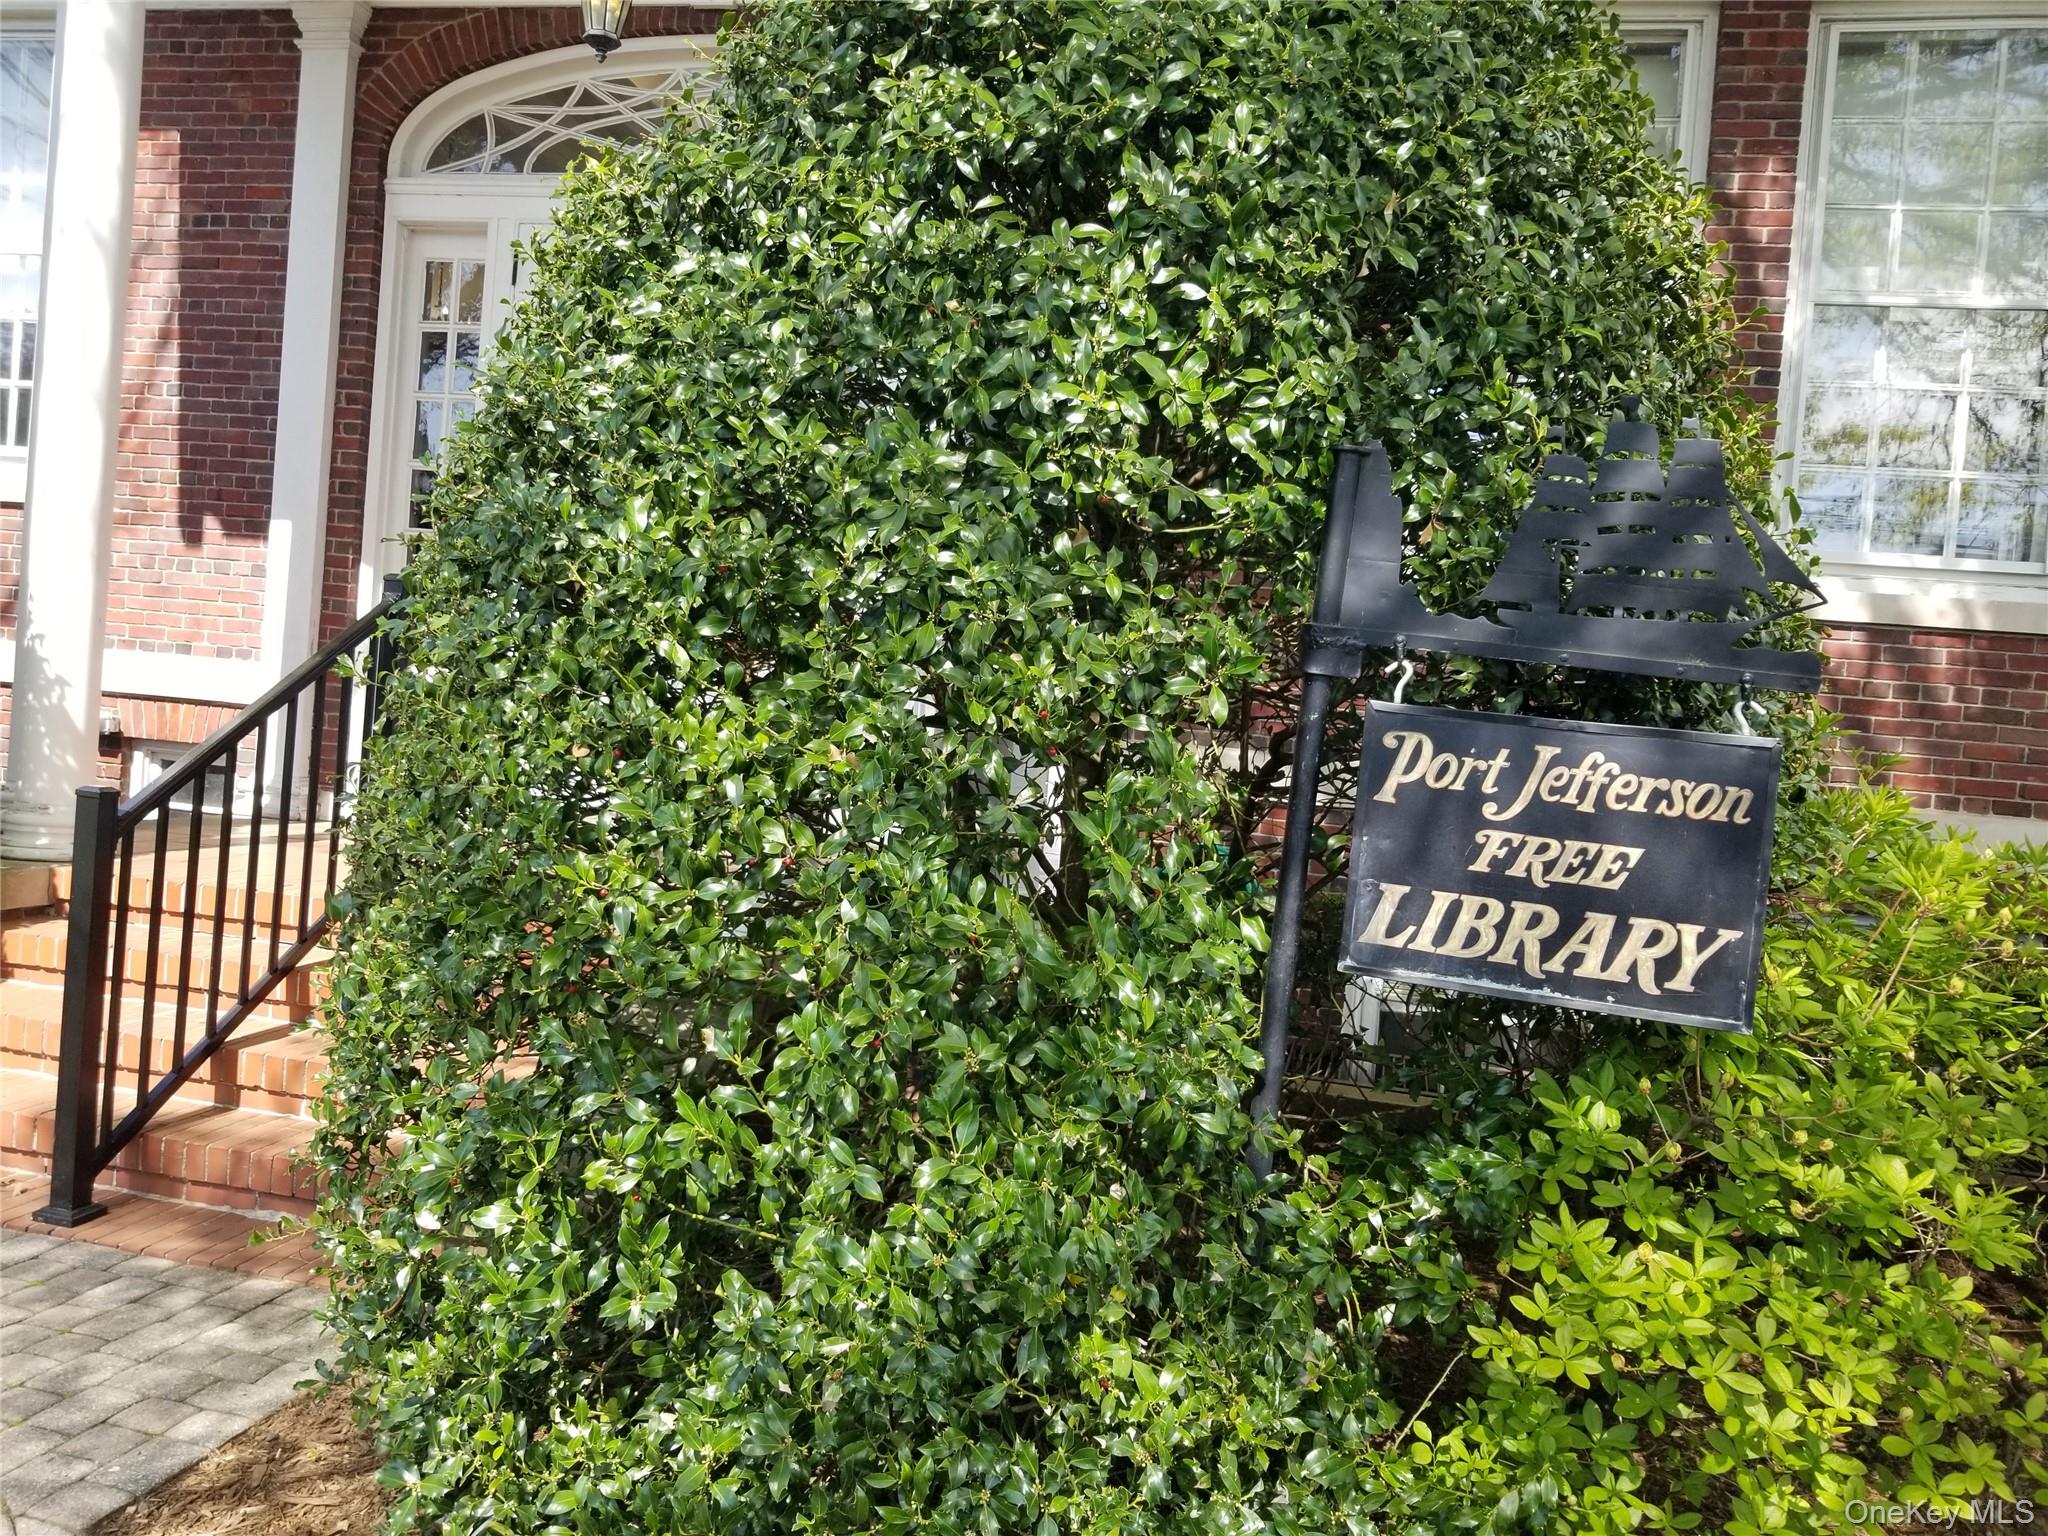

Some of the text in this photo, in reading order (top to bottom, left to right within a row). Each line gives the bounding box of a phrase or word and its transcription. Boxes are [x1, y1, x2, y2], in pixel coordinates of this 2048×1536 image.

[1373, 731, 1755, 824] Port Jefferson
[1467, 829, 1646, 890] FREE
[1358, 882, 1744, 995] LIBRARY
